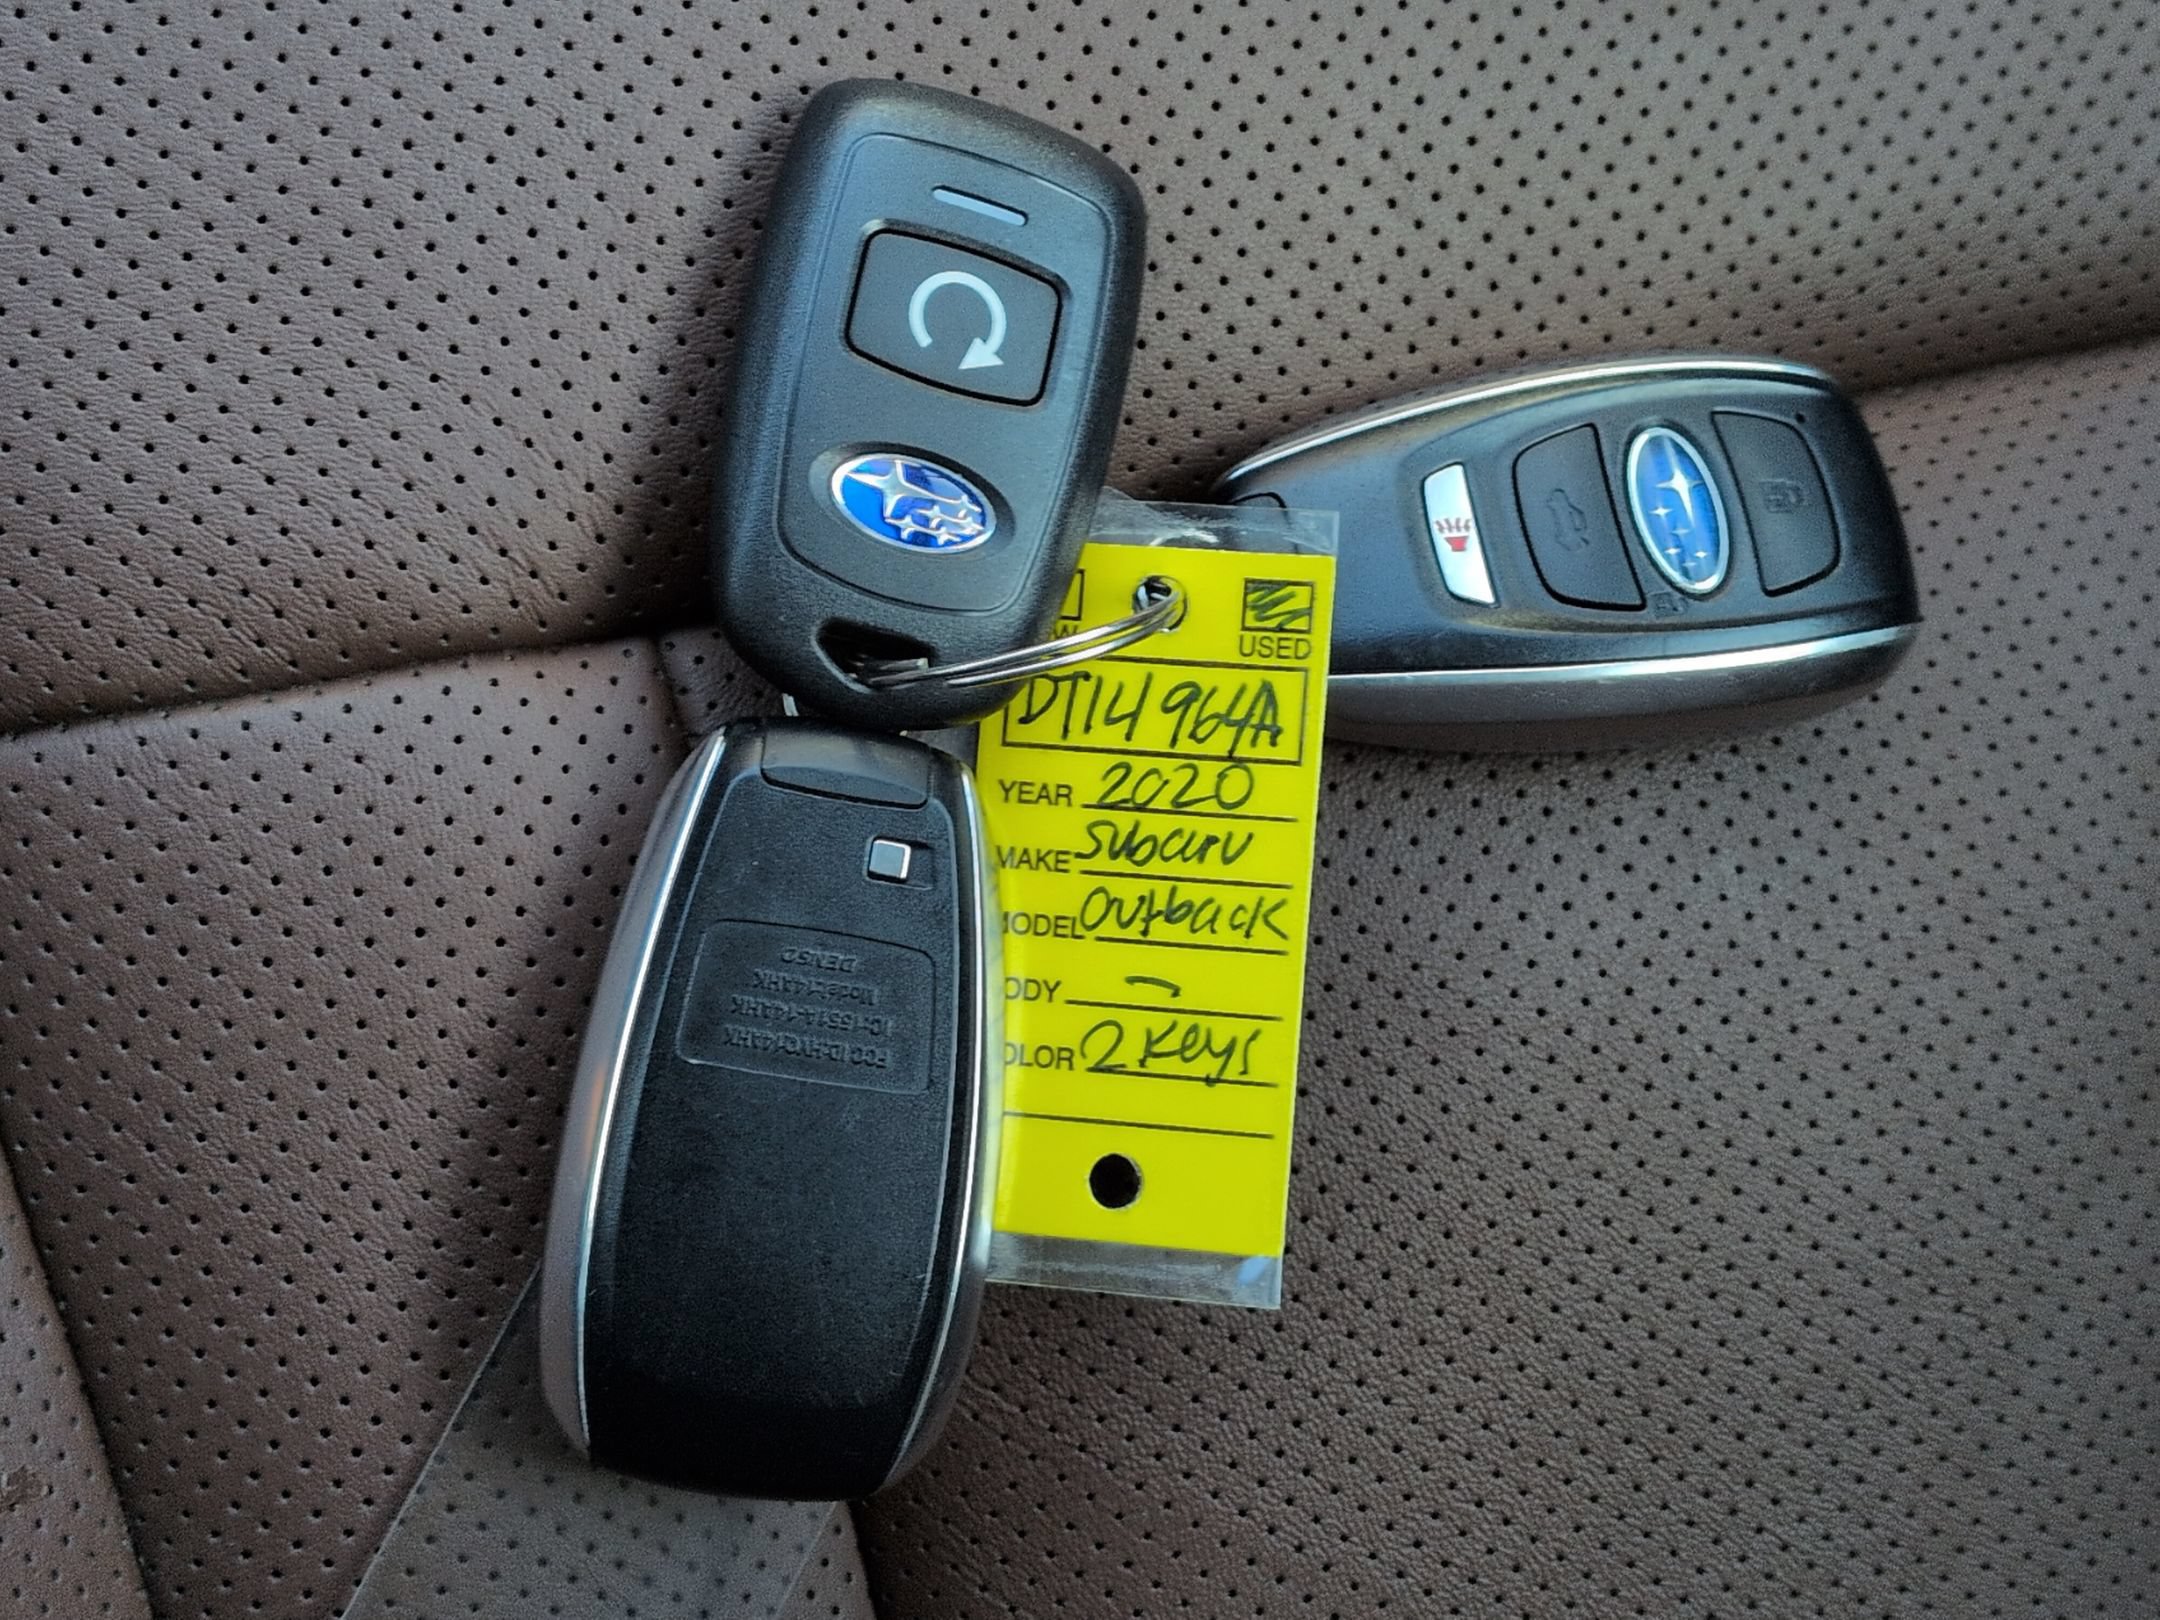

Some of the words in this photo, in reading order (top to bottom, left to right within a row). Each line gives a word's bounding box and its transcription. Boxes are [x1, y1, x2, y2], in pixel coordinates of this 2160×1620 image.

[1238, 635, 1313, 660] USED
[998, 779, 1073, 807] YEAR
[1097, 761, 1254, 810] 2020
[1004, 976, 1062, 1004] ODY
[1004, 1041, 1075, 1071] OLOR
[1080, 1019, 1127, 1072] 2
